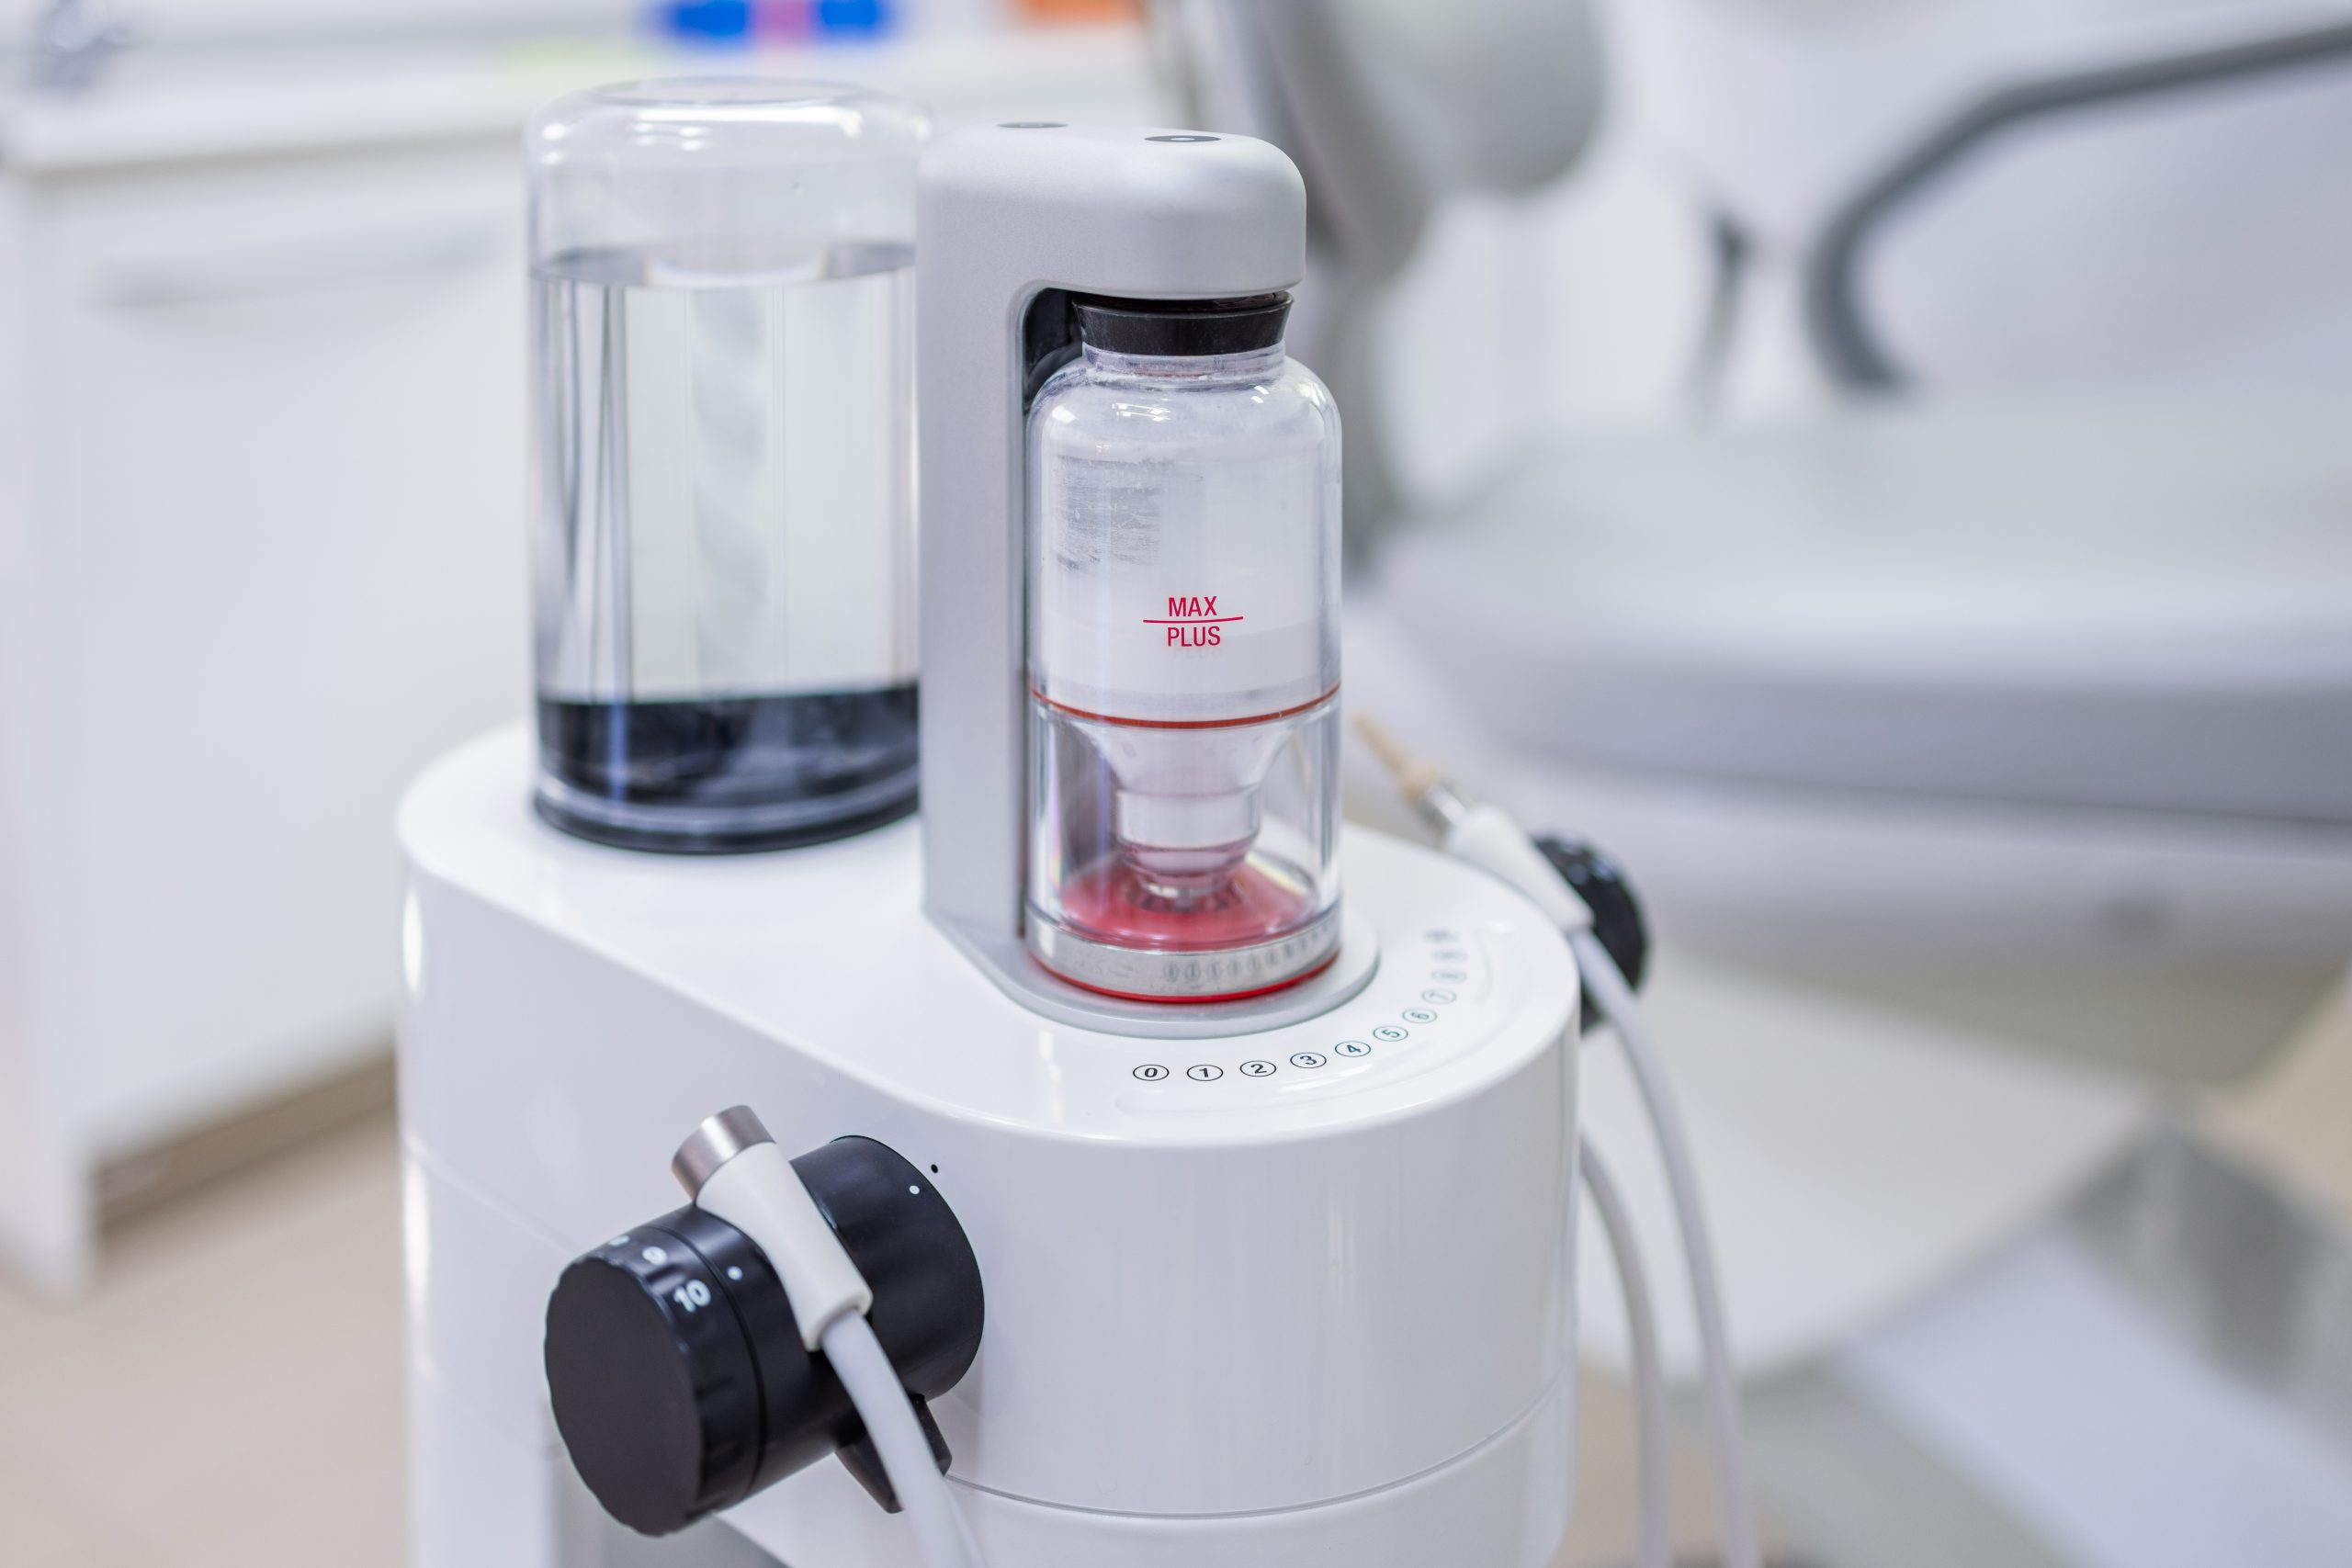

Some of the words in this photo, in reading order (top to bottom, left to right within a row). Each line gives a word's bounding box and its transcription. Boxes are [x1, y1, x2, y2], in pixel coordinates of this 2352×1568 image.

[1168, 596, 1217, 617] MAX
[1167, 626, 1221, 648] PLUS
[673, 1279, 711, 1314] 10
